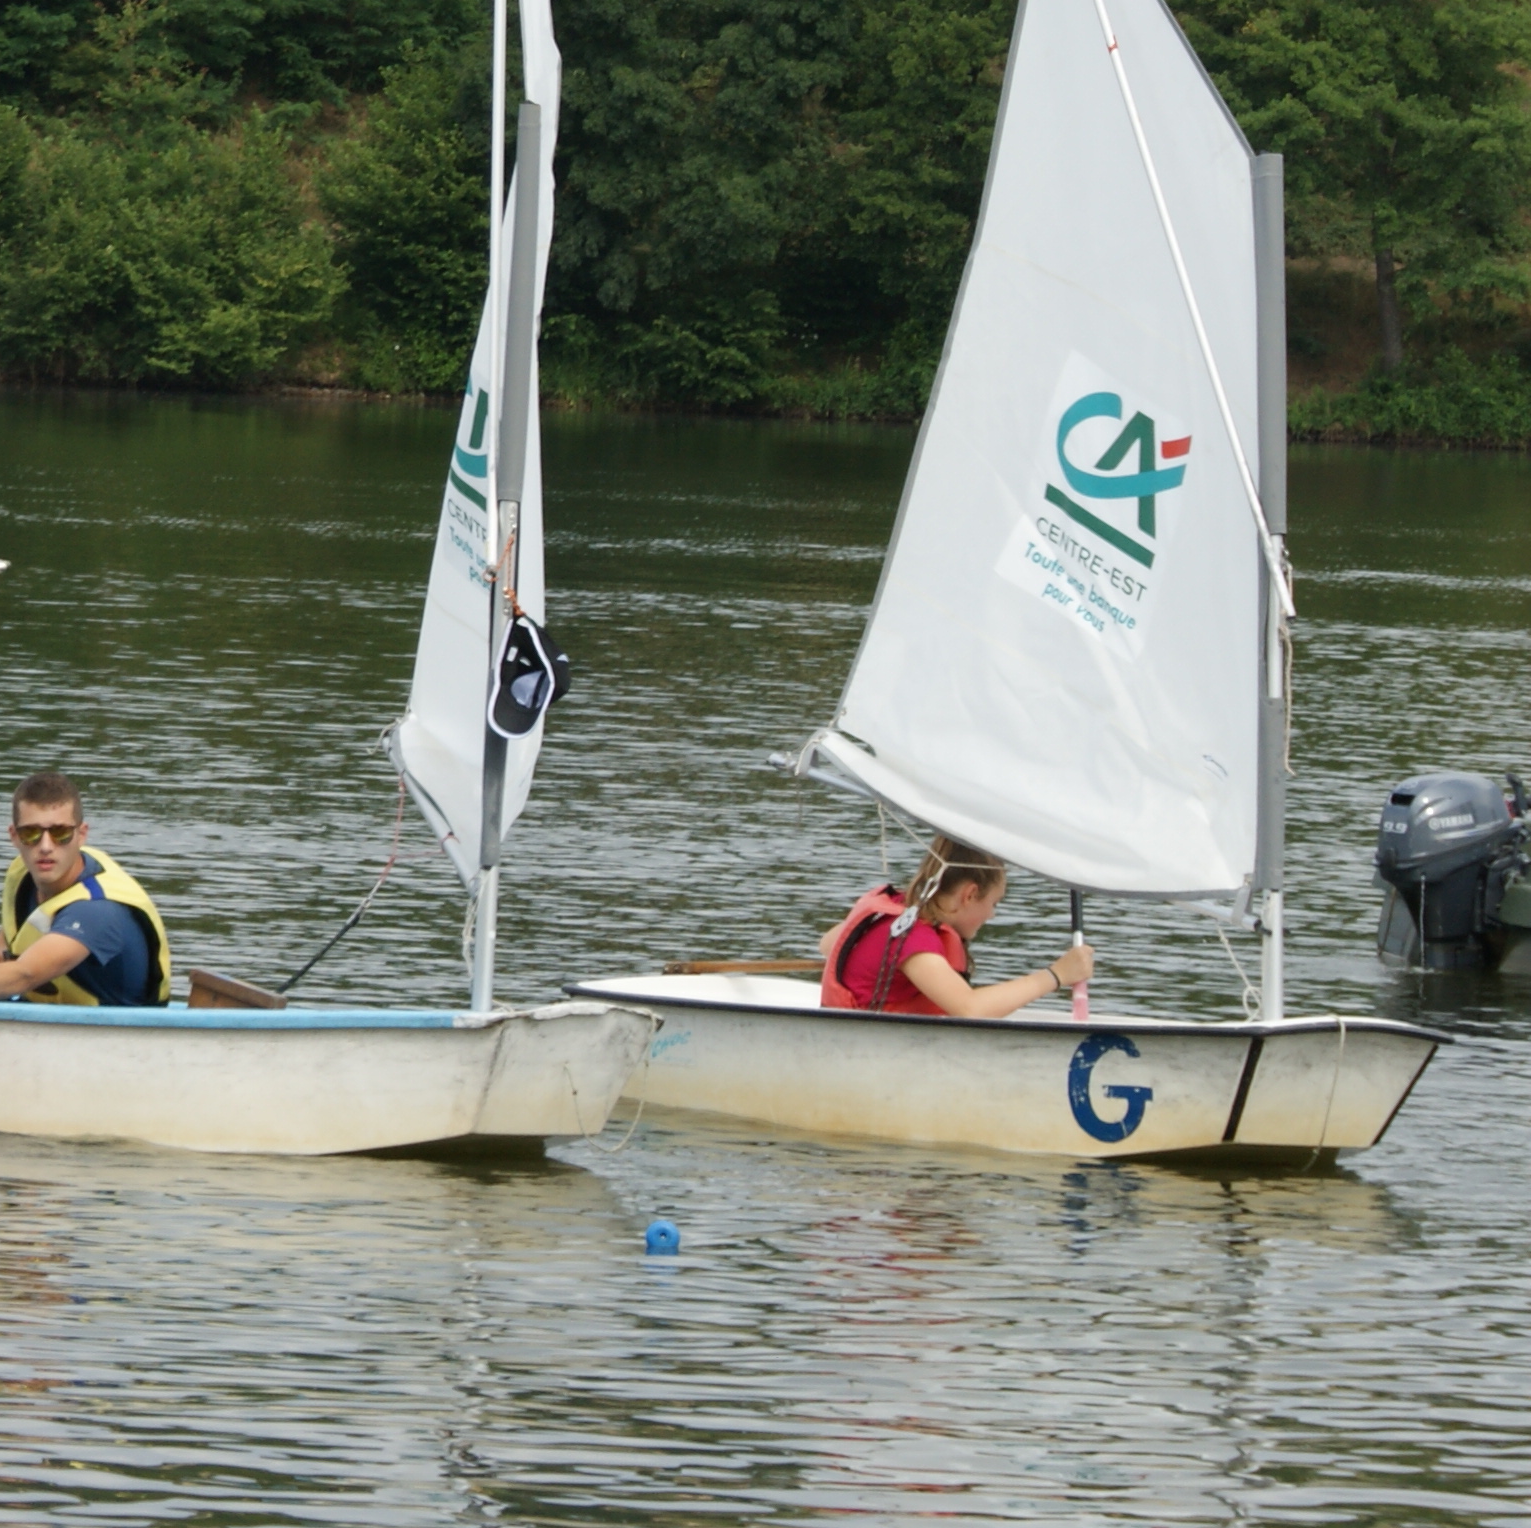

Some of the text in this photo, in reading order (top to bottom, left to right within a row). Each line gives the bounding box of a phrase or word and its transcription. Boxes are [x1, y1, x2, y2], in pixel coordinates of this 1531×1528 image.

[1024, 541, 1065, 577] Toute
[1088, 583, 1137, 630] banque
[1036, 516, 1148, 602] CENTRE-EST
[1042, 582, 1105, 632] pour vous
[1068, 1032, 1153, 1144] G
